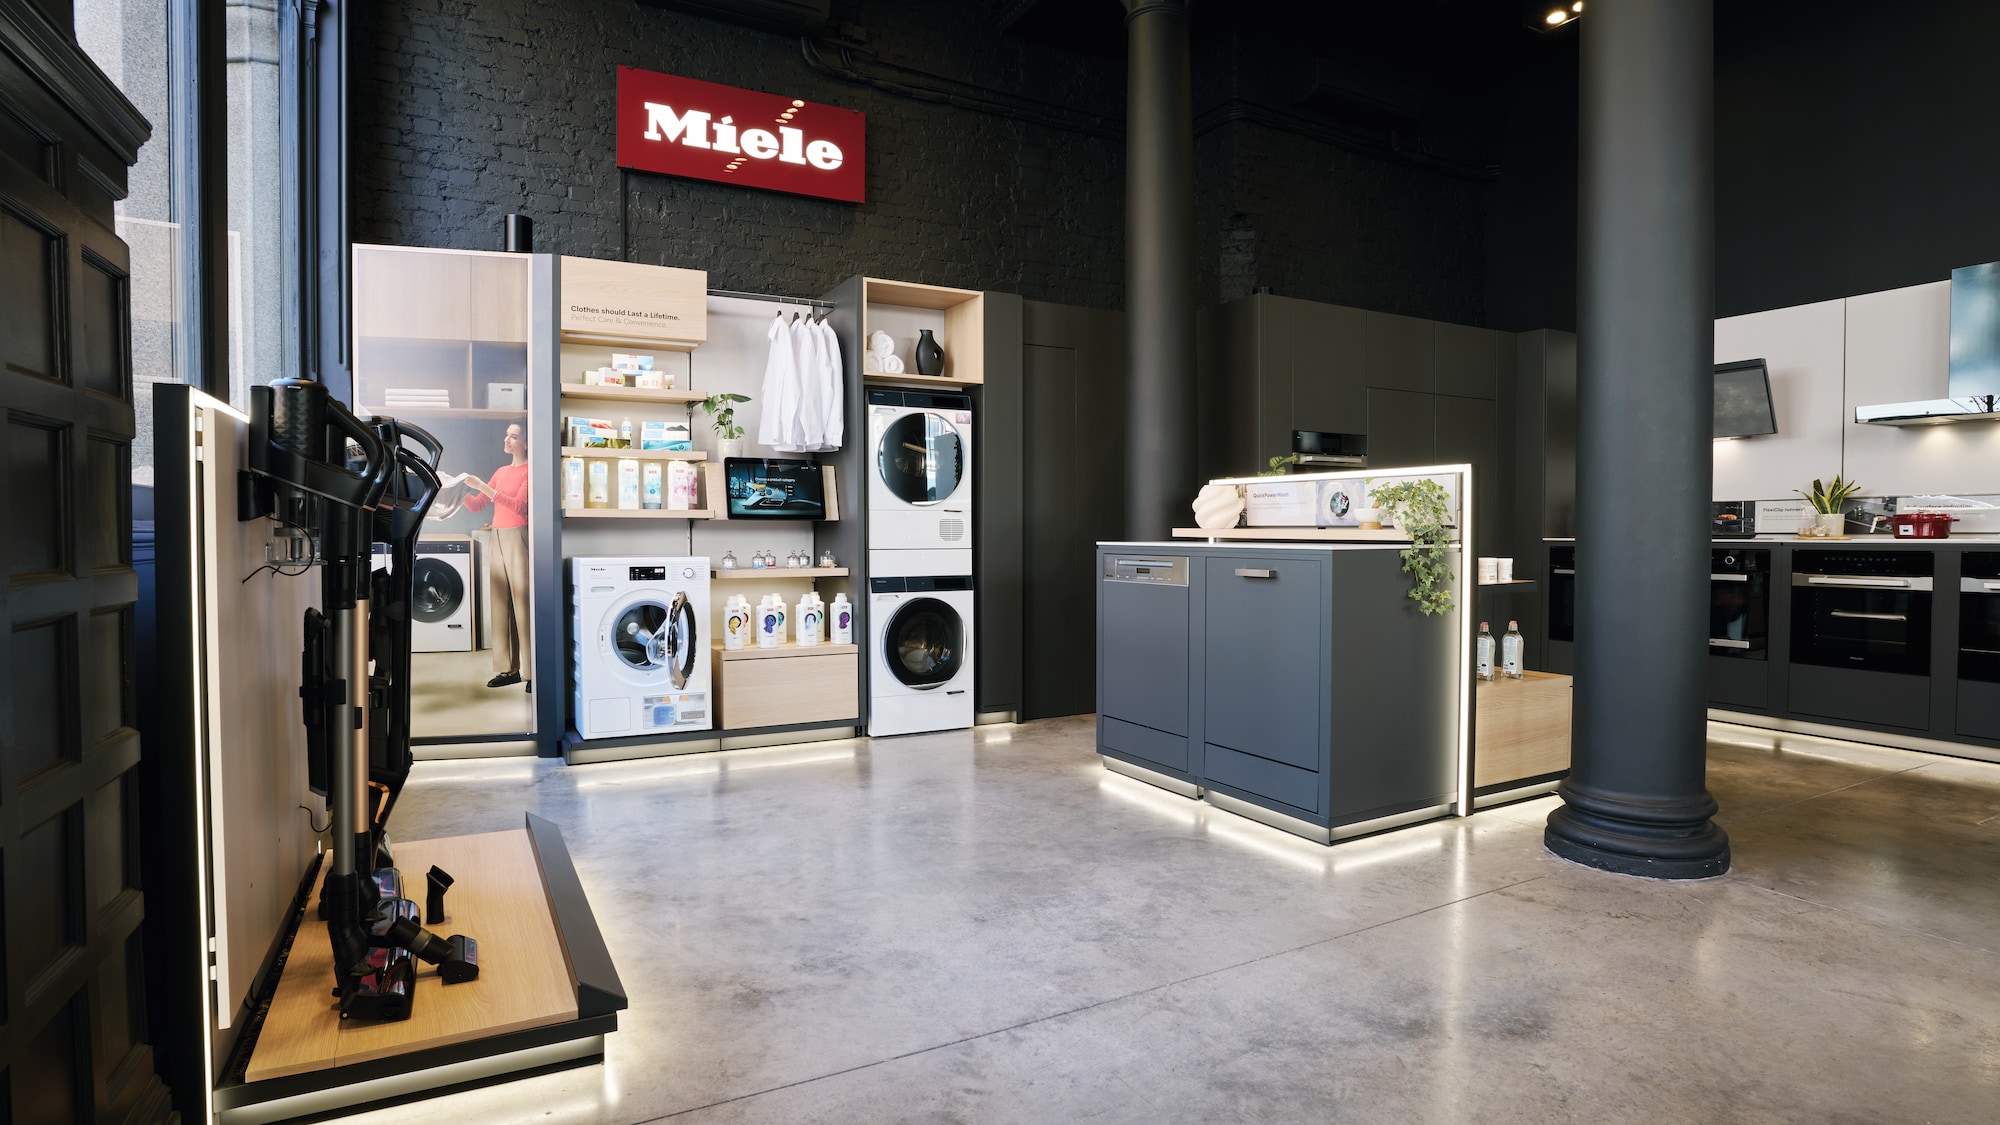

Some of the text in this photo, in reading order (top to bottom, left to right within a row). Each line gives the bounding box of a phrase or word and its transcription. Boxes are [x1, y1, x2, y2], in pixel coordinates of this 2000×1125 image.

[643, 101, 844, 170] Miele
[570, 305, 600, 314] Clothes
[601, 307, 626, 316] should
[627, 310, 643, 318] Last
[650, 311, 680, 321] Lifetime.
[571, 313, 597, 322] Perfect
[597, 315, 614, 324] Care
[1252, 491, 1289, 499] QuickPowerWash
